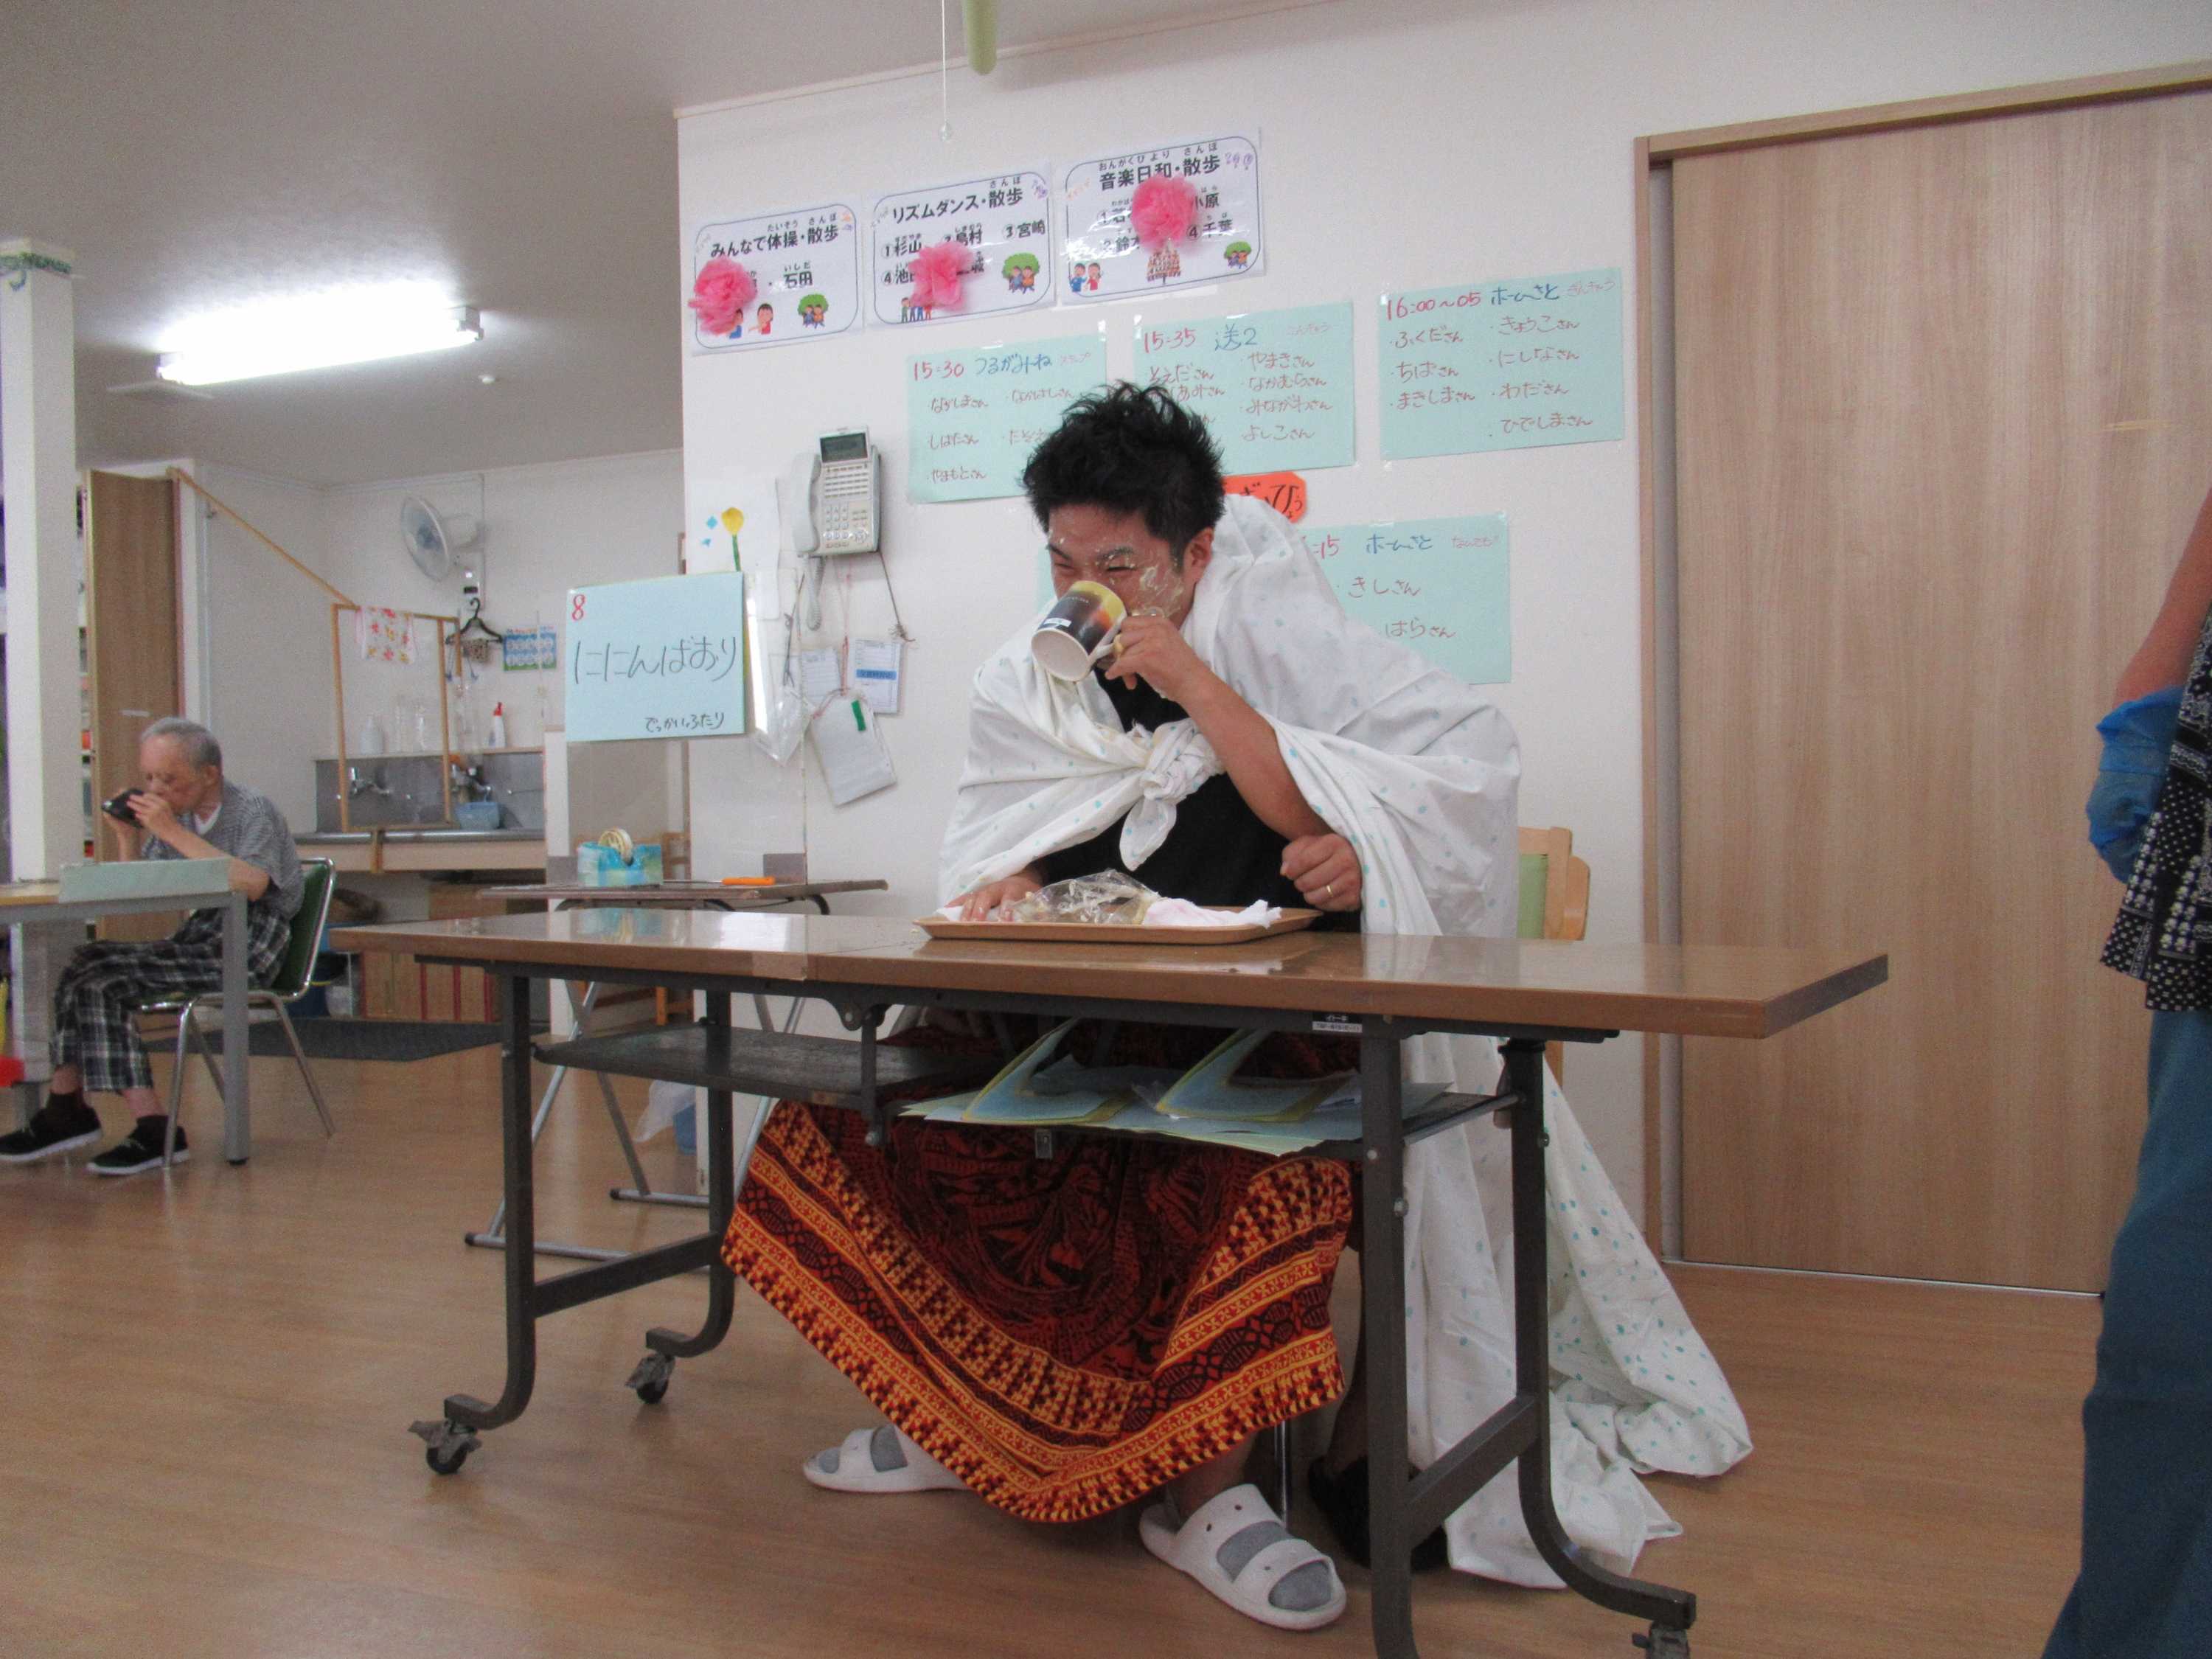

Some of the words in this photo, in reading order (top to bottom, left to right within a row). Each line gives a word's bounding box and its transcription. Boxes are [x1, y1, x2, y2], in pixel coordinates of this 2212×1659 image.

[1099, 154, 1220, 191] 音楽日和・散歩
[893, 188, 1023, 224] リズムダンス・散歩
[710, 225, 838, 257] みんなで体操・散歩
[784, 271, 813, 289] 石田
[1215, 324, 1257, 351] 送2
[975, 353, 1052, 375] つるがみね
[571, 594, 585, 622] 8
